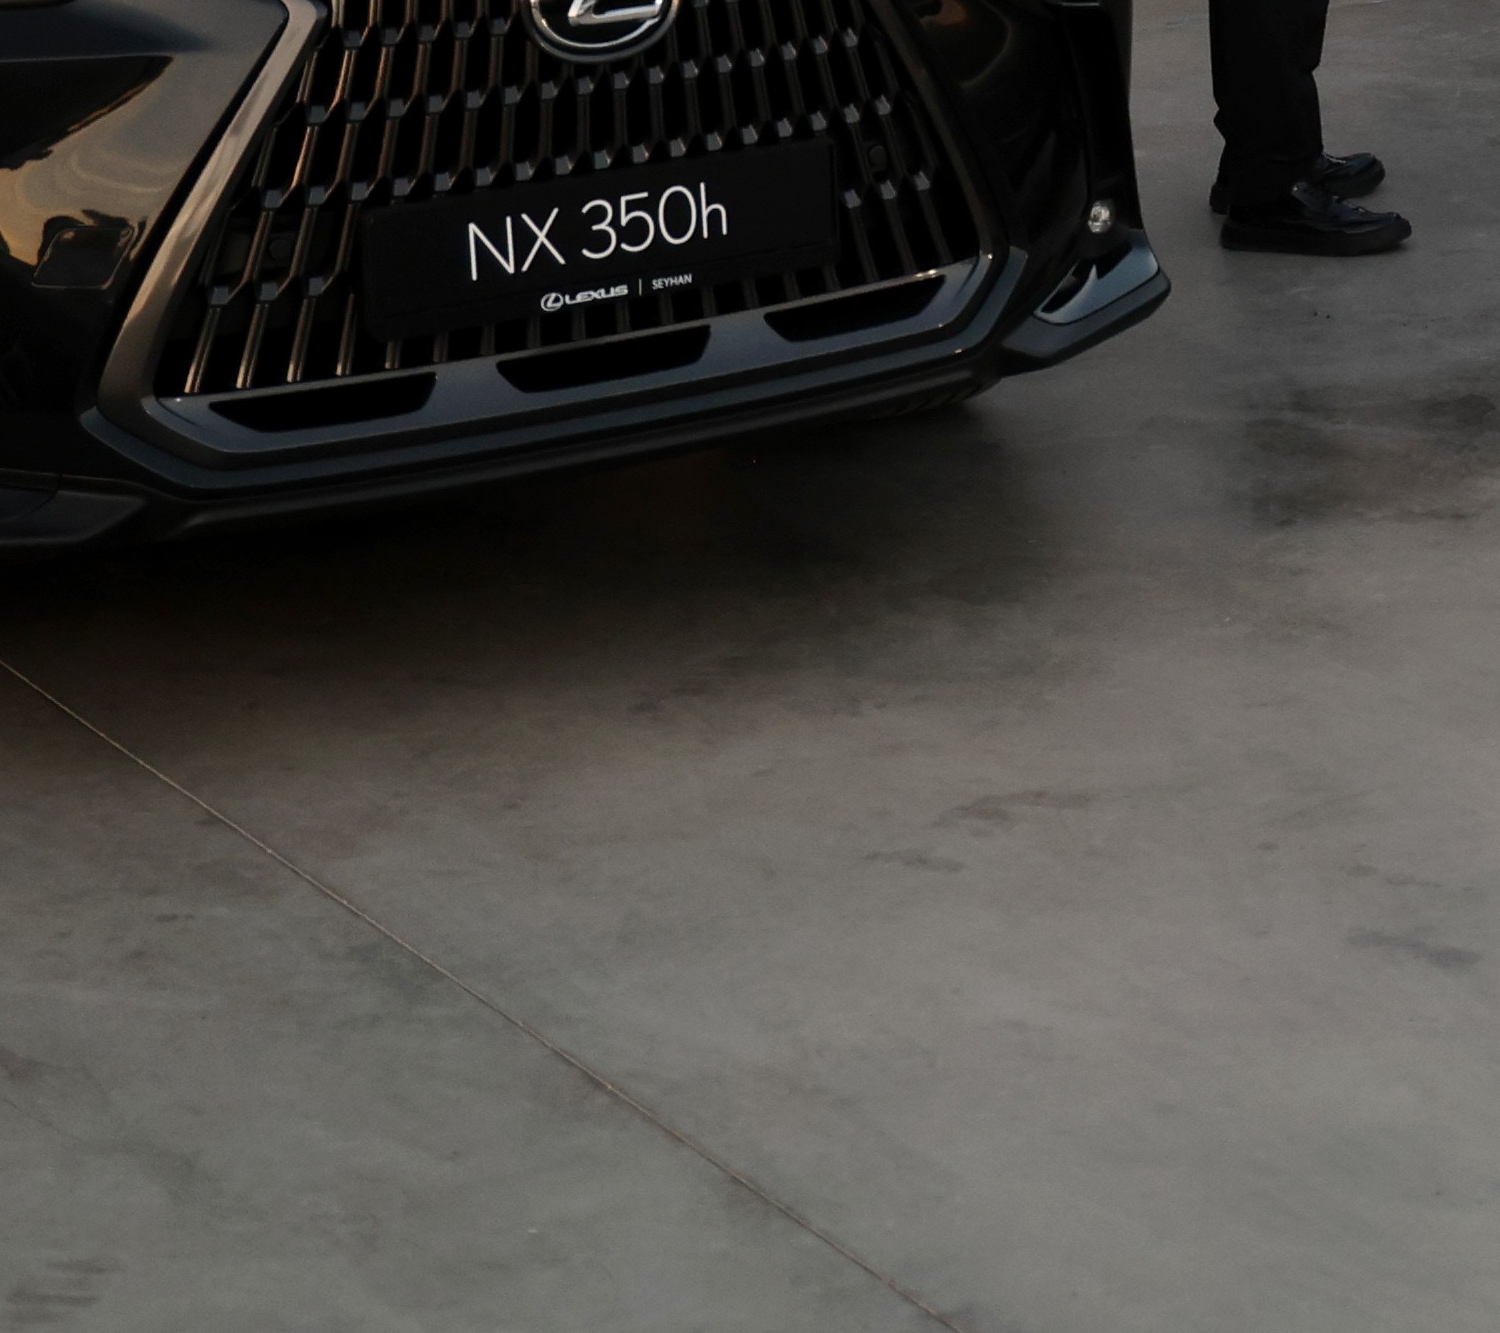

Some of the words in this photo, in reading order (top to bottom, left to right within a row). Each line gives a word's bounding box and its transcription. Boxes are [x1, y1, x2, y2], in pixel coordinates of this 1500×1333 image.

[467, 207, 567, 282] NX
[580, 181, 729, 260] 350h
[564, 284, 629, 305] LEXUS
[651, 273, 693, 290] SEYHAN
